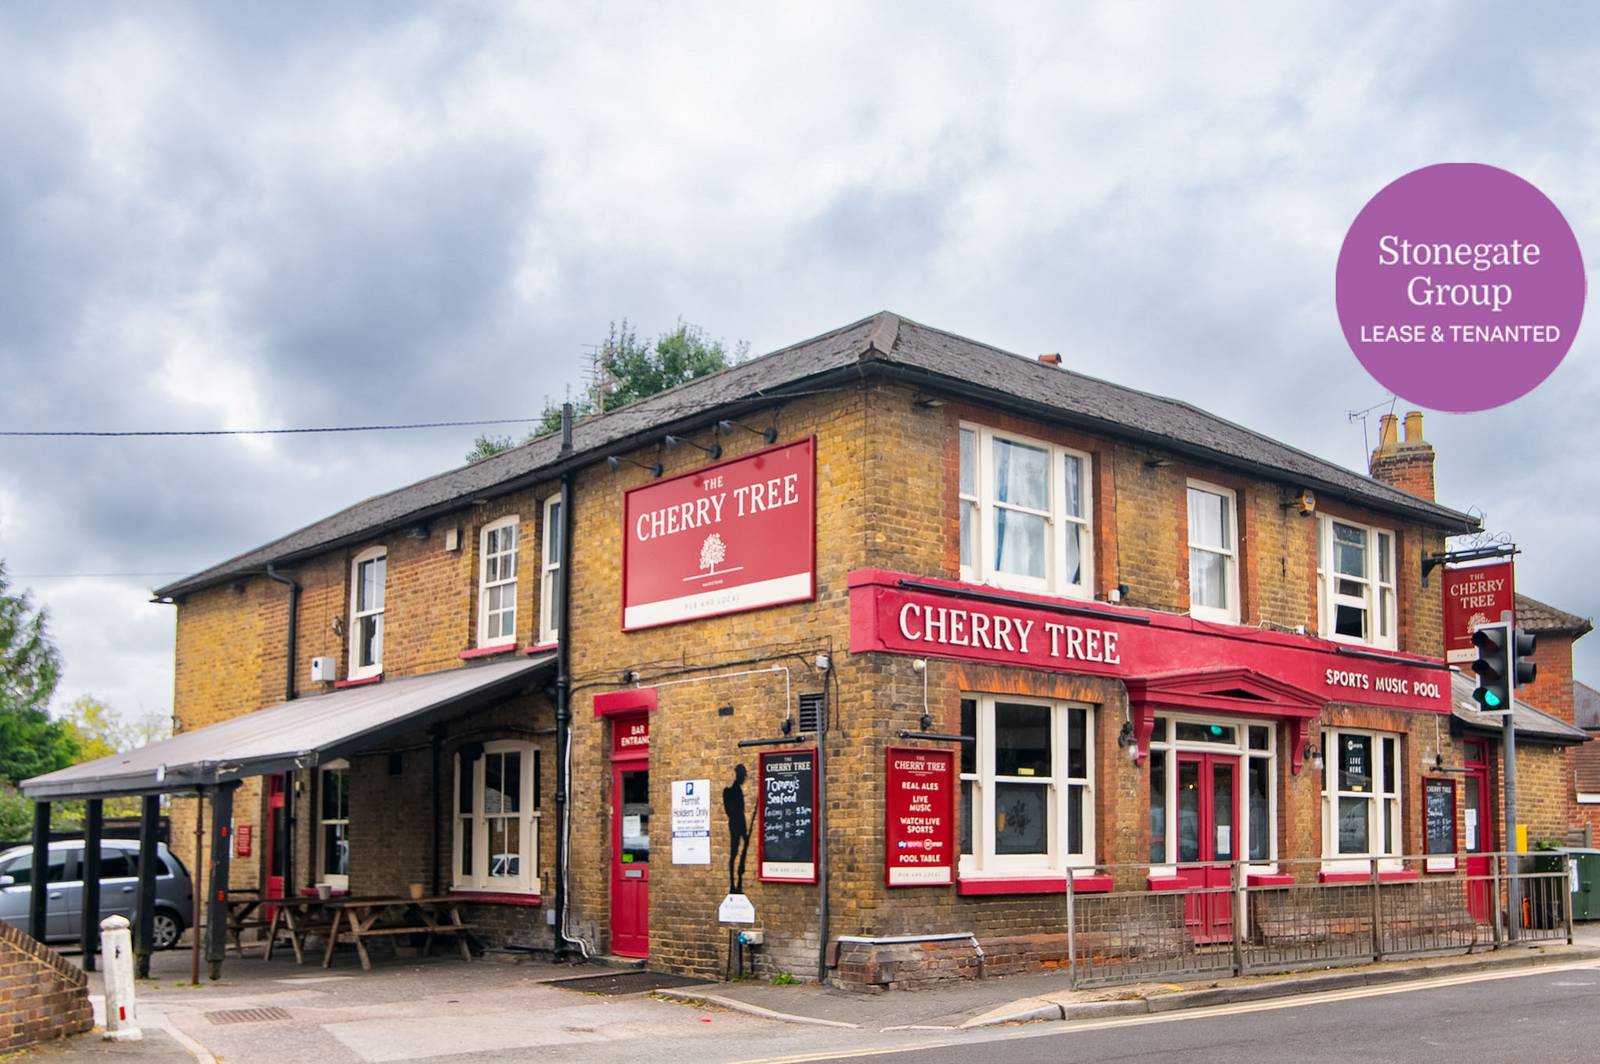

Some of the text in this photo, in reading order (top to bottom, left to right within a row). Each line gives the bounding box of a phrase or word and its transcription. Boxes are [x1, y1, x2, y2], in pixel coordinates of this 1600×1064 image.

[703, 476, 724, 491] THE
[636, 474, 799, 542] CHERRY TREE
[1470, 572, 1485, 580] THE
[1450, 578, 1504, 597] CHERRY
[1460, 594, 1496, 609] TREE
[898, 602, 1121, 665] CHERRY TREE
[1325, 668, 1441, 699] SPORTS MUSIC POOL
[631, 725, 645, 735] BAR
[621, 735, 650, 747] ENTRANC
[766, 761, 811, 772] CHERRY TREE
[894, 760, 946, 772] CHERRY TREE
[764, 776, 800, 793] Tommy's
[902, 781, 939, 791] REAL ALES
[767, 792, 797, 804] Seafood
[912, 795, 928, 804] LIVE
[909, 804, 932, 812] MUSIC
[900, 817, 940, 826] WATCH LIVE
[907, 826, 934, 834] SPORTS
[899, 854, 940, 863] POOL TABLE
